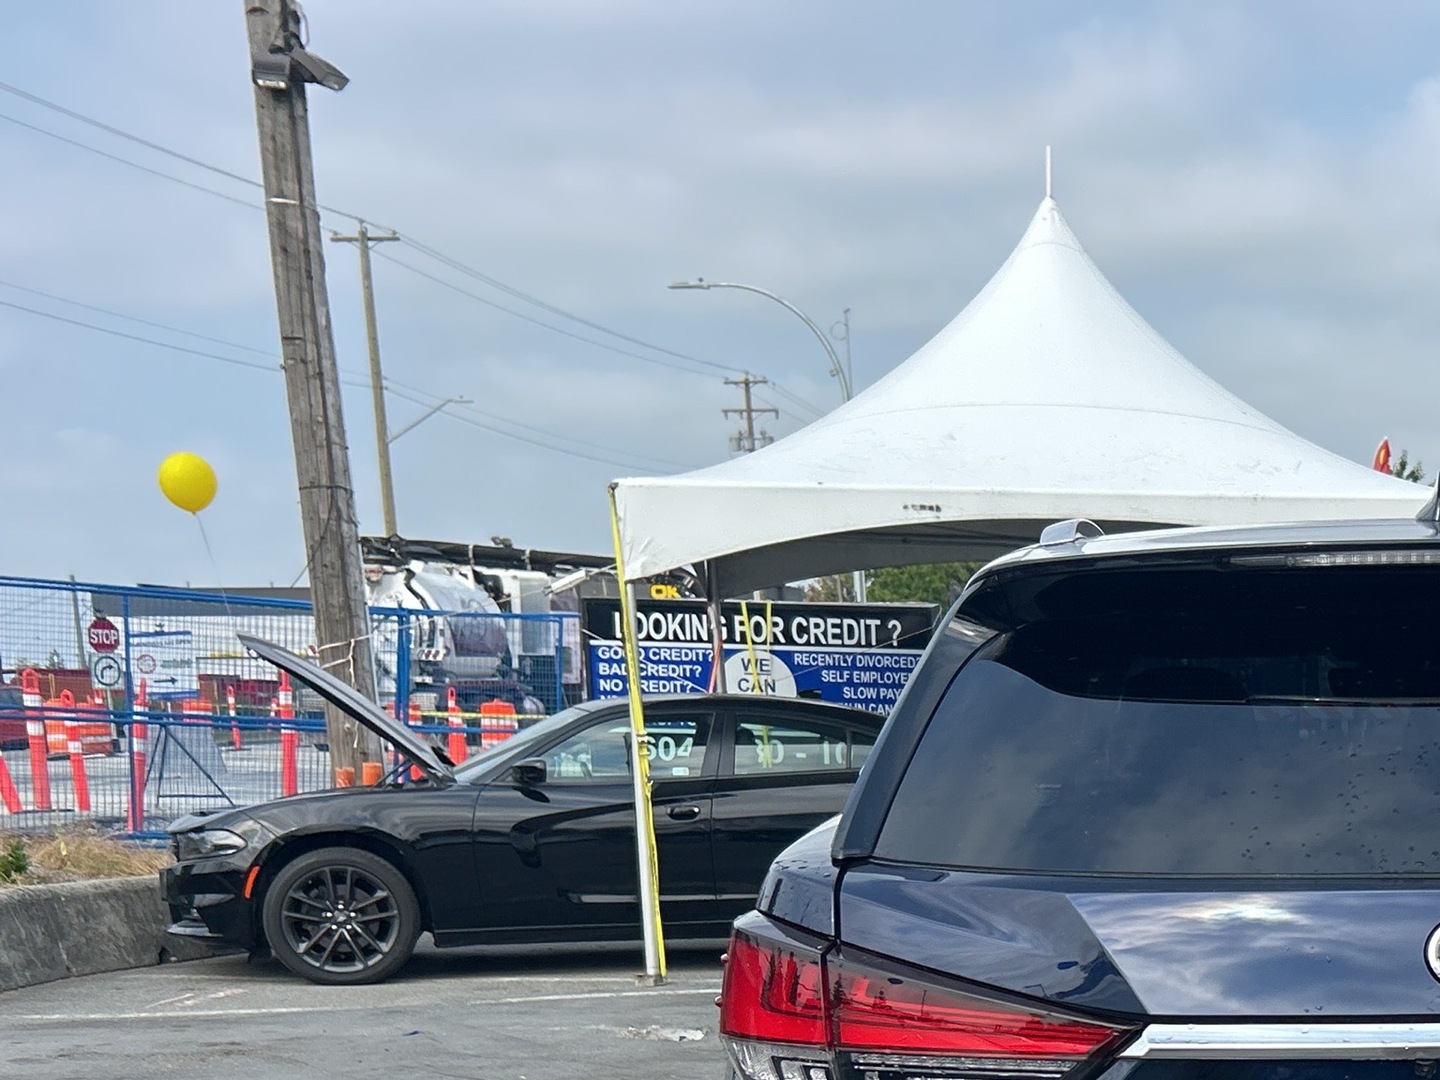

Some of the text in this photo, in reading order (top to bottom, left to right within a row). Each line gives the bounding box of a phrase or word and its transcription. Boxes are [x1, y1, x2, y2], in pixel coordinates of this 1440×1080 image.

[650, 584, 682, 599] OK
[89, 628, 119, 646] STOP
[734, 614, 786, 644] FOR
[791, 616, 881, 646] CREDIT
[887, 619, 902, 647] ?
[598, 646, 714, 662] GOD CREDIT?
[794, 653, 854, 667] RECENTLY
[639, 664, 702, 678] CREDIT?
[741, 658, 771, 673] WE
[821, 670, 850, 682] SELF
[599, 679, 692, 694] NO REDIT?
[738, 678, 777, 693] CAN
[843, 686, 903, 700] SLOW PAY
[868, 703, 894, 716] CAN
